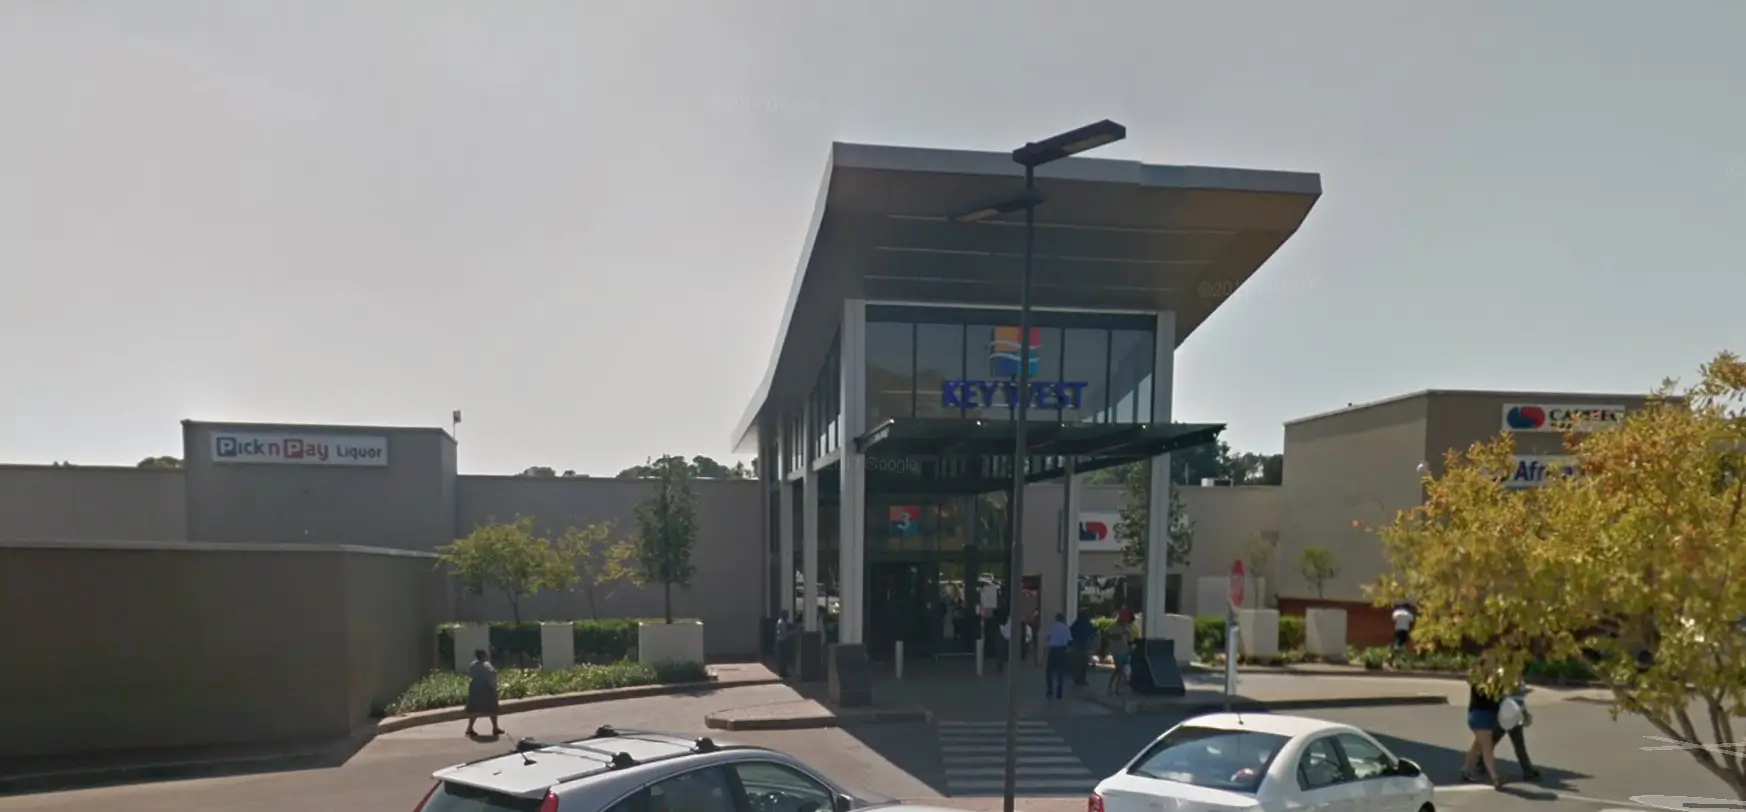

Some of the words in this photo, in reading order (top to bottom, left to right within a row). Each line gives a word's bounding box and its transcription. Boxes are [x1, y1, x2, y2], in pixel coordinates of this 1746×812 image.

[944, 380, 998, 408] KEY
[1001, 381, 1088, 409] WEST
[1549, 408, 1623, 421] CAEC
[216, 437, 265, 457] Pick
[268, 441, 280, 456] n
[283, 438, 328, 461] Pay
[336, 444, 383, 460] Liquor
[896, 511, 911, 530] 3
